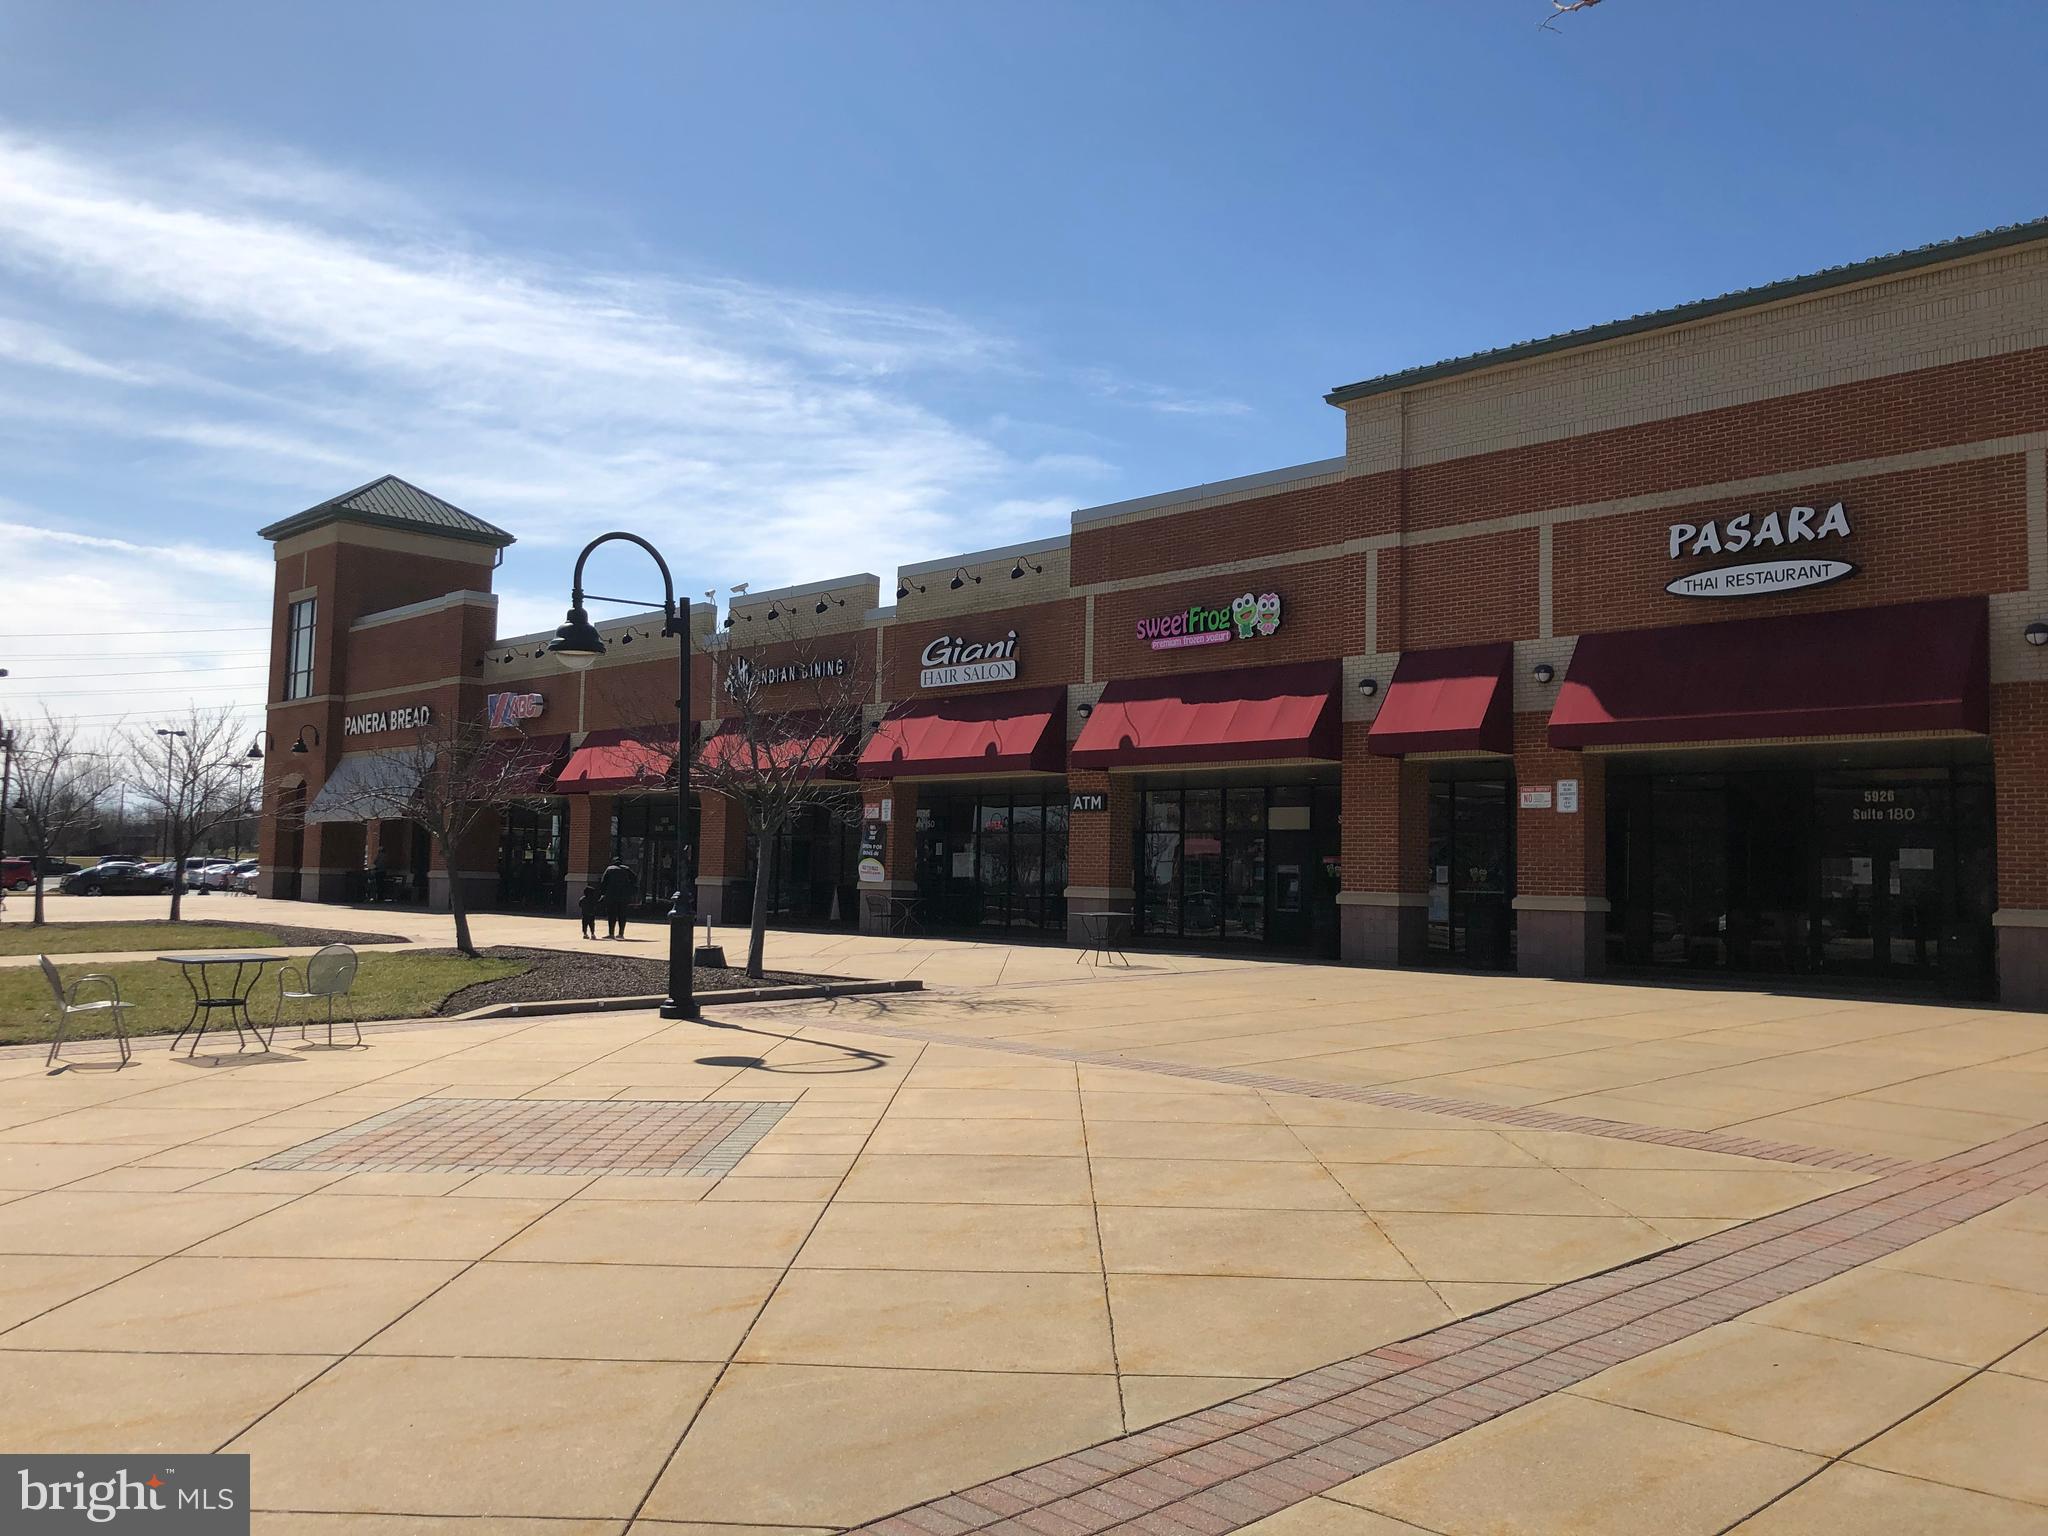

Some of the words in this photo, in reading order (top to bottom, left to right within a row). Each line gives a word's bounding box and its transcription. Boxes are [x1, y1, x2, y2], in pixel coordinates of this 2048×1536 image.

[1669, 502, 1850, 559] PASARA
[1684, 577, 1718, 593] THAI
[1725, 563, 1832, 588] RESTAURANT
[1136, 606, 1230, 640] sweetFrog
[921, 630, 1016, 667] Giani
[1184, 635, 1205, 645] frozen
[757, 666, 795, 685] NDIAN
[924, 668, 959, 685] HAIR
[963, 662, 1014, 681] SALON
[344, 711, 387, 736] PANERA
[390, 706, 430, 729] BREAD
[1072, 795, 1102, 810] ATM
[1523, 793, 1533, 803] NO
[1852, 808, 1884, 820] Suite
[1887, 807, 1915, 820] 180
